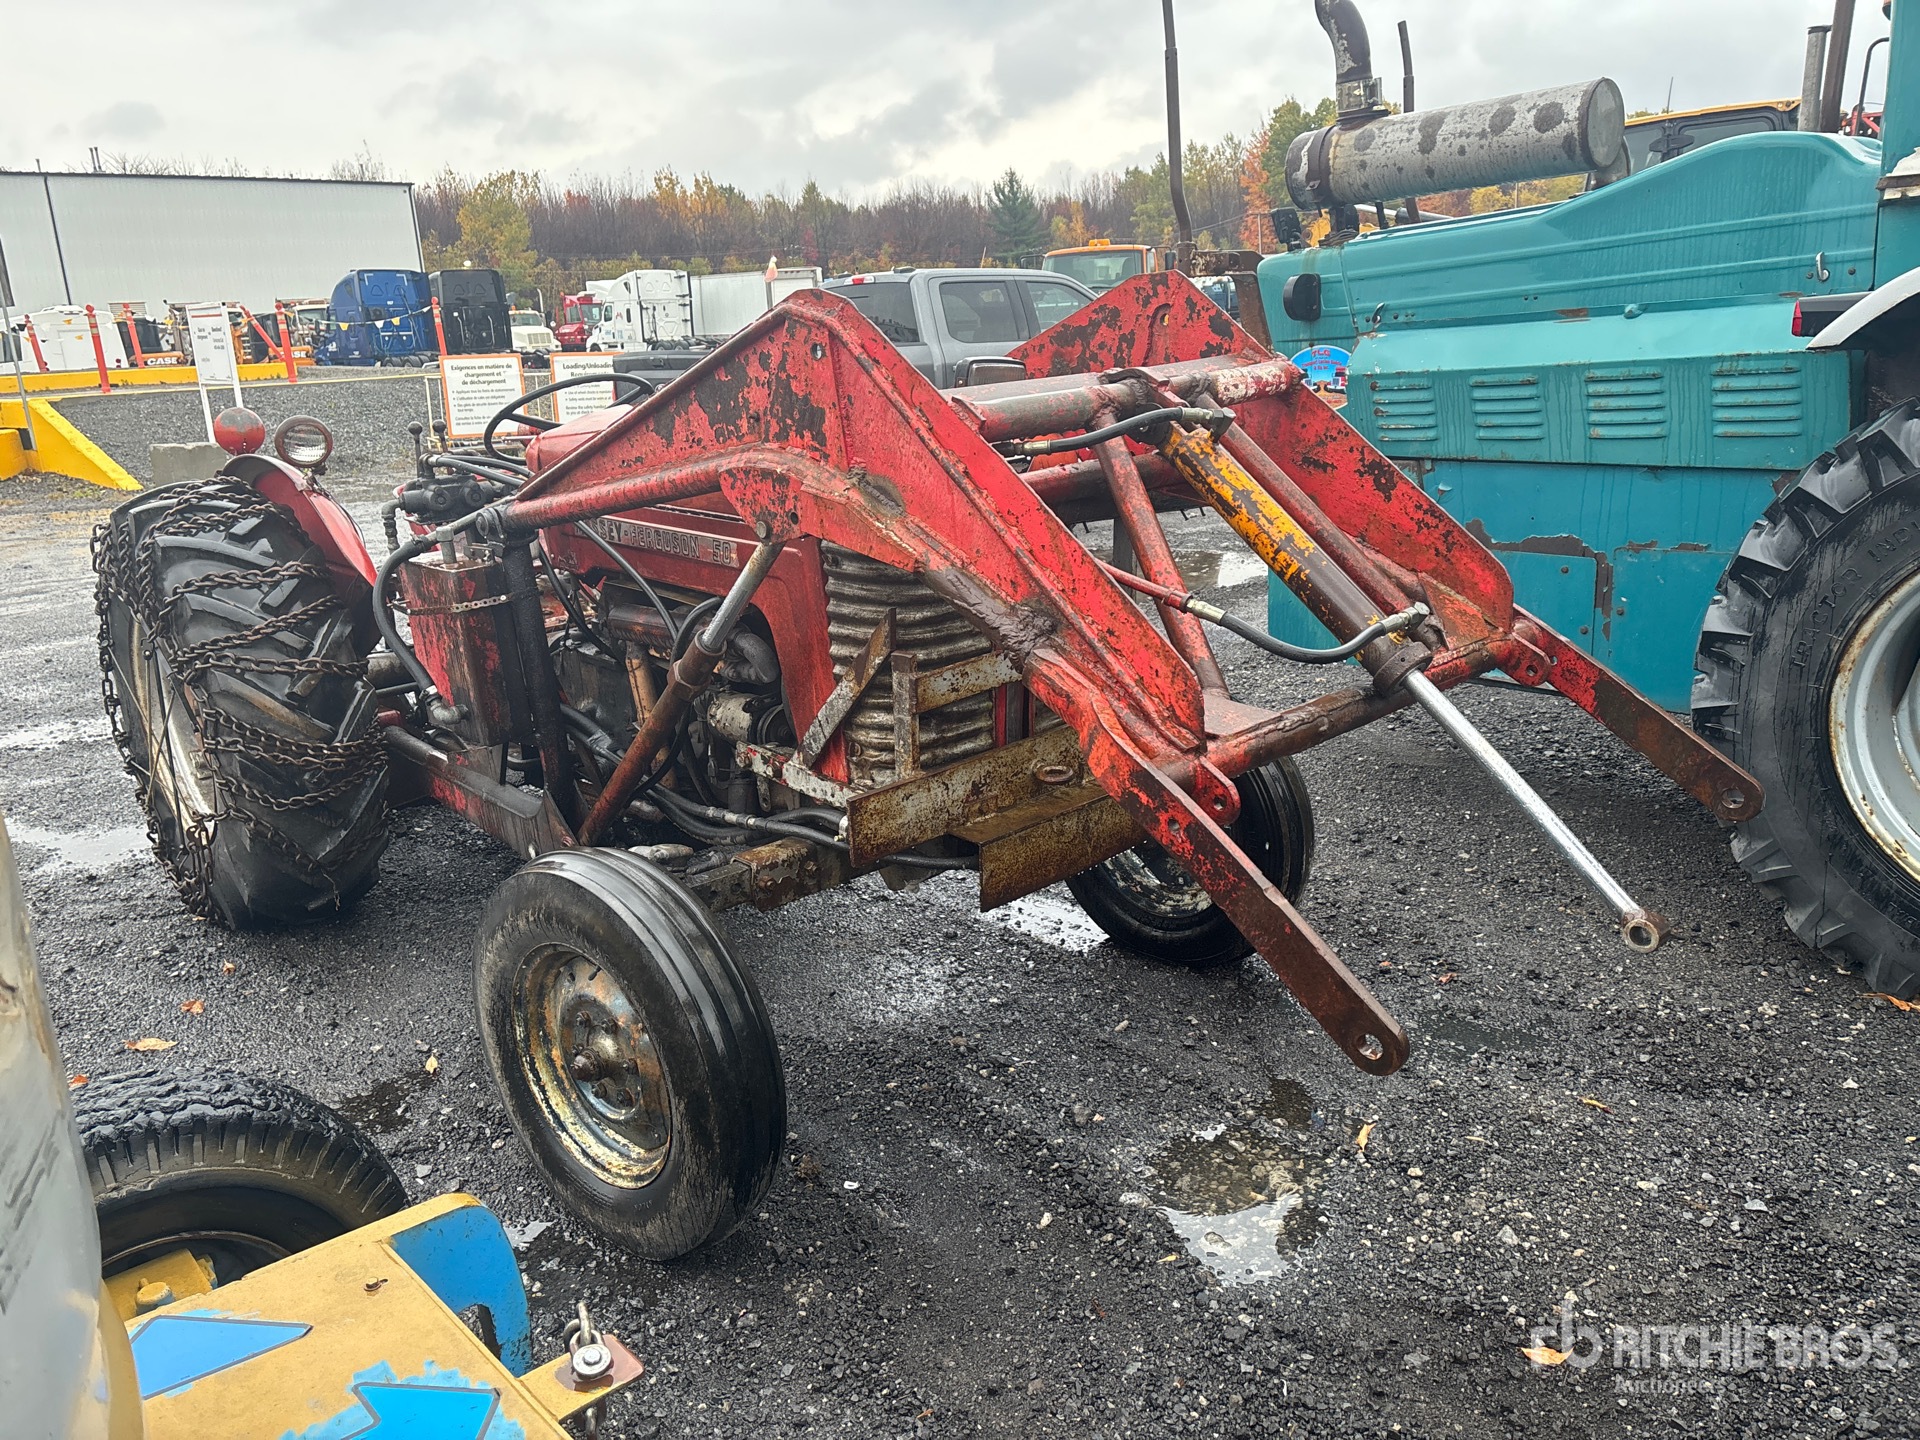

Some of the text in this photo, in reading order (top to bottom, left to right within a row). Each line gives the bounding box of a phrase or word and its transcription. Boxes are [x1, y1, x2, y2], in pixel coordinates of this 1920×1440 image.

[147, 357, 178, 365] CASE
[575, 518, 732, 565] SSEY-FERGUSON 50
